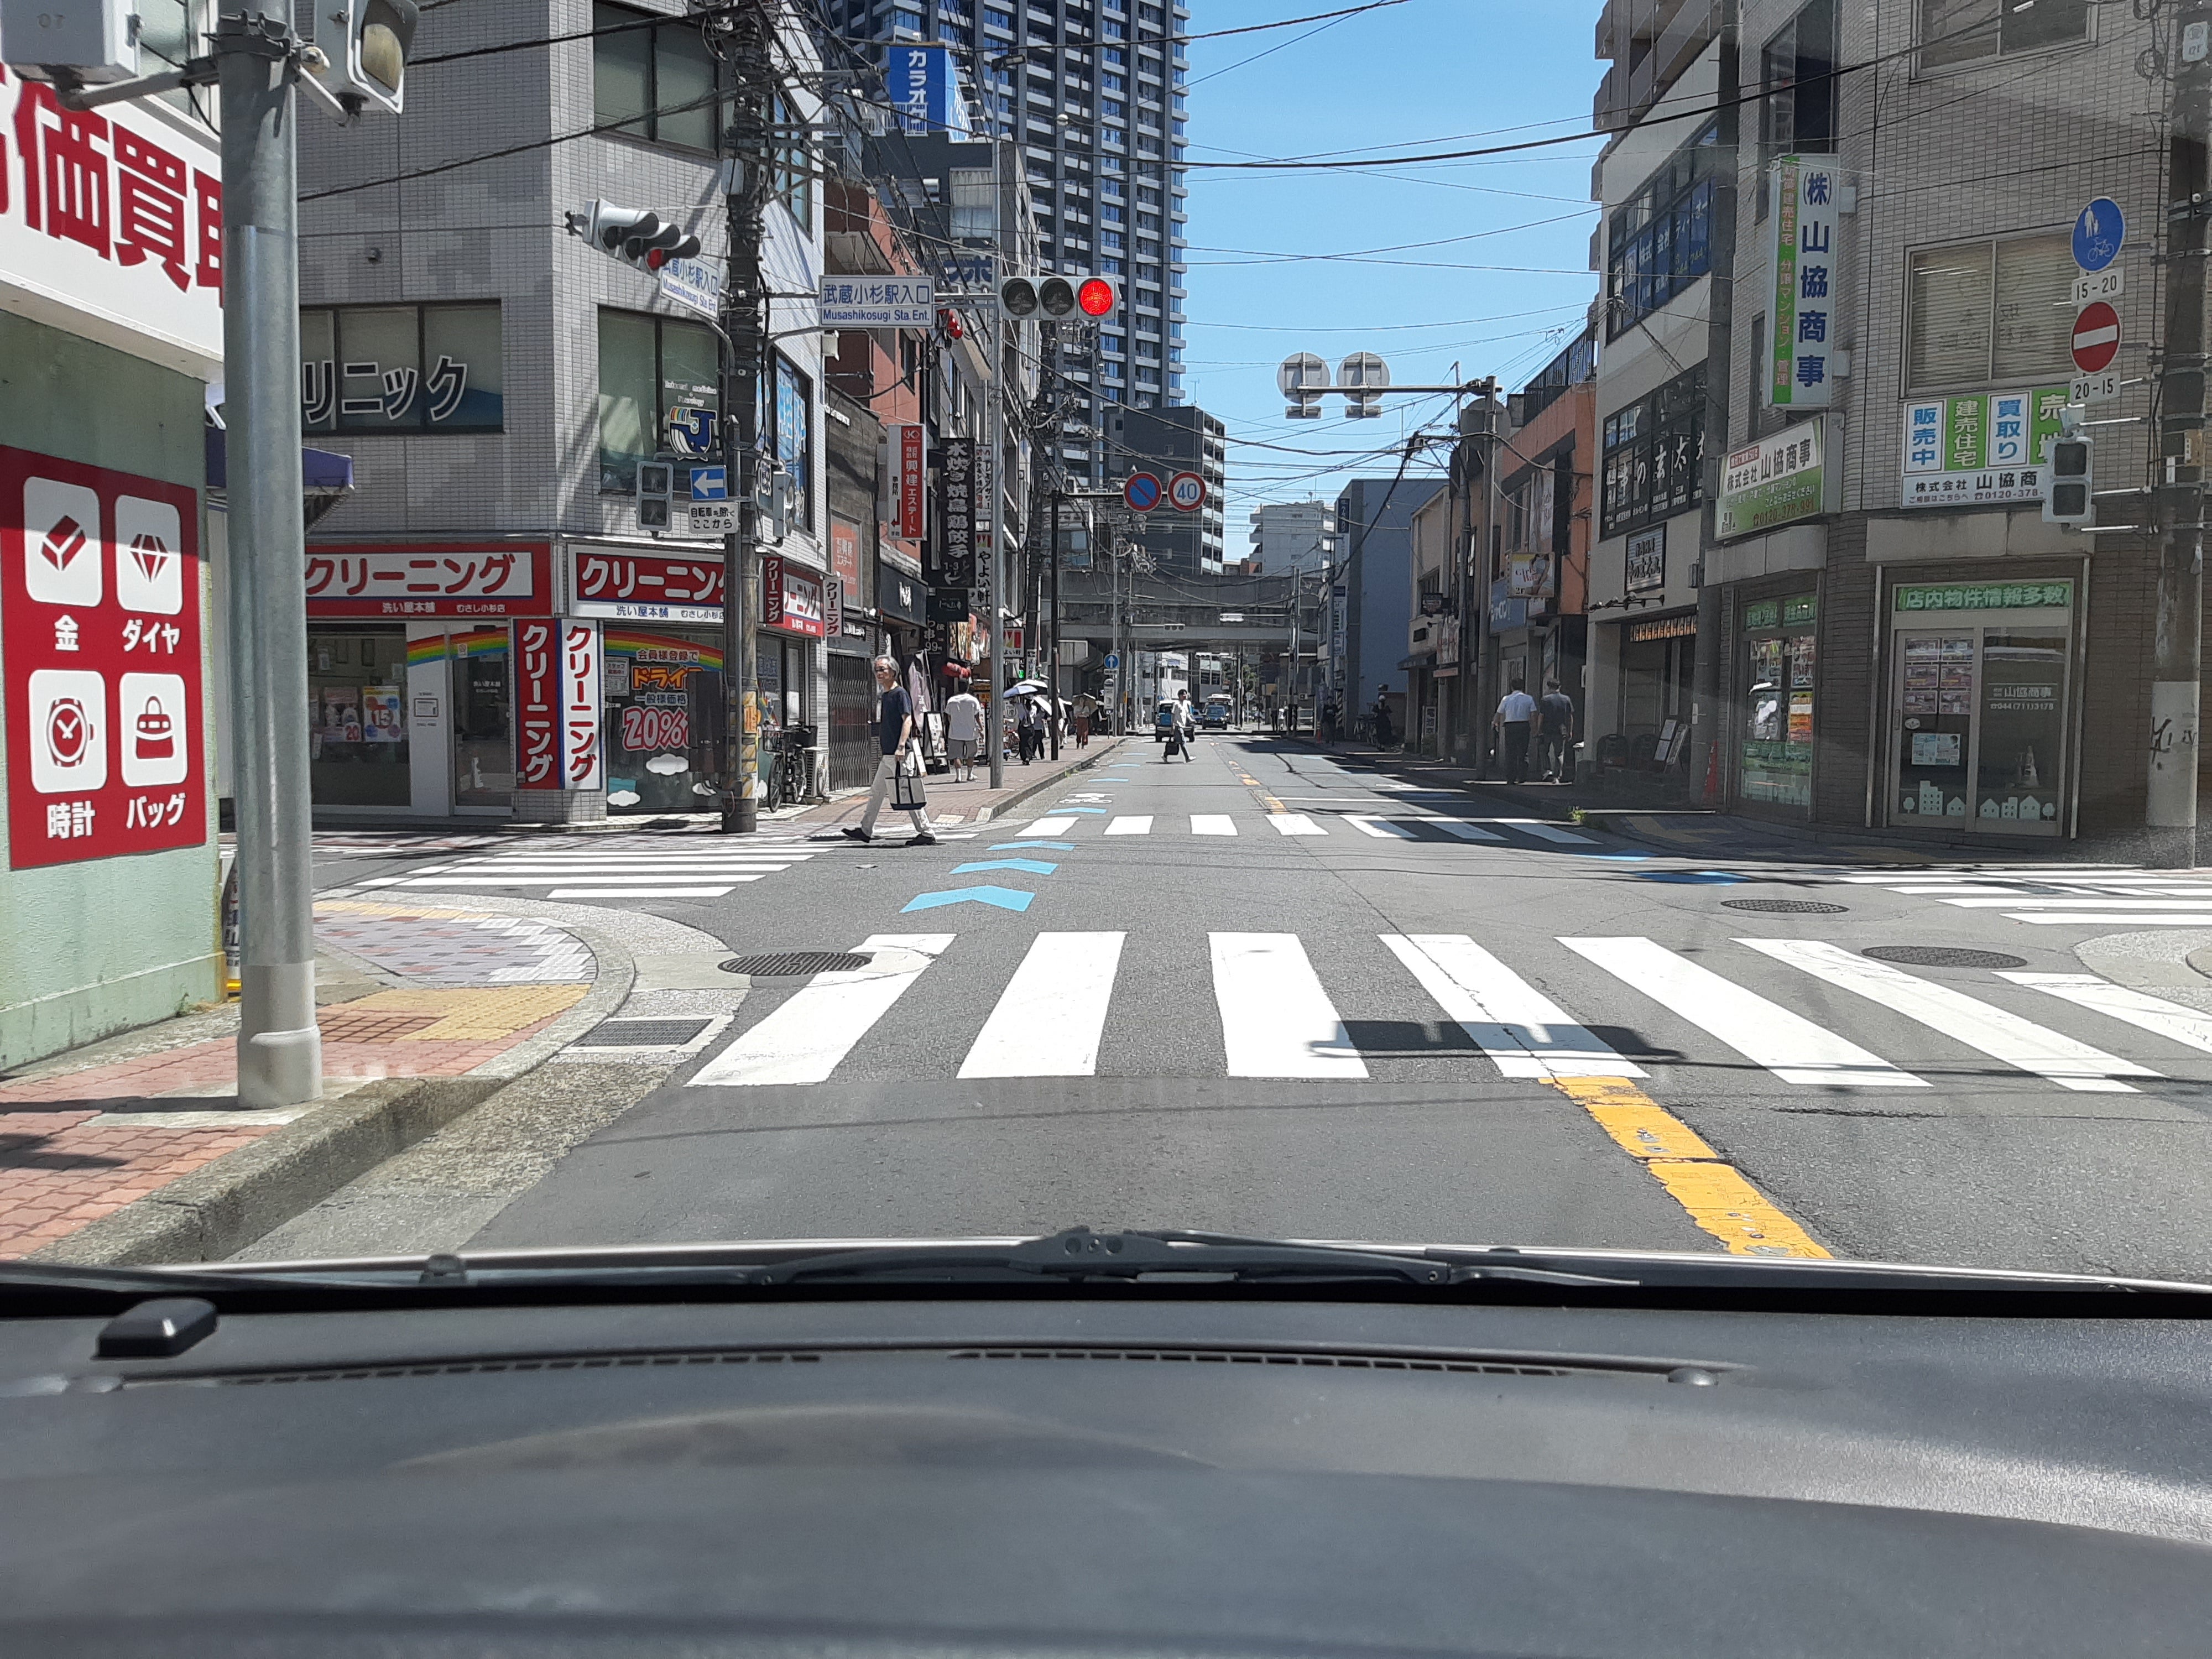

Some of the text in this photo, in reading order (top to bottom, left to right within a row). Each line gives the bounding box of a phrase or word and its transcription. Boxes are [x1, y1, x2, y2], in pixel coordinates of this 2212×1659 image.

[907, 50, 928, 124] カラオケ
[0, 62, 223, 309] 価買
[823, 284, 930, 305] 武蔵小杉駅入口
[2076, 275, 2117, 300] 15-20
[823, 309, 890, 322] Musashikosugi
[913, 309, 930, 321] Ent.
[302, 354, 467, 424] リニック
[2074, 378, 2115, 402] 20-15
[1912, 407, 1937, 466] 販売中
[1953, 399, 1979, 467] 建売住宅
[1995, 399, 2021, 460] 買取り
[1176, 482, 1197, 500] 40
[693, 519, 732, 529] ここから
[305, 554, 515, 595] クリーニング
[582, 557, 724, 602] クリーニン
[768, 560, 780, 622] クリーニング
[978, 551, 991, 603] やよい軒
[616, 606, 669, 618] 洗い屋本舗
[826, 582, 839, 635] クリーニング
[1905, 585, 2065, 609] 店内物件情報多数
[54, 615, 80, 651] 金
[122, 619, 180, 654] ダイヤ
[632, 667, 703, 691] ドライ
[523, 625, 554, 782] クリーニング
[566, 627, 597, 782] クリーニング
[623, 706, 688, 750] 20%
[47, 801, 95, 838] 時計
[127, 793, 185, 828] バッグ
